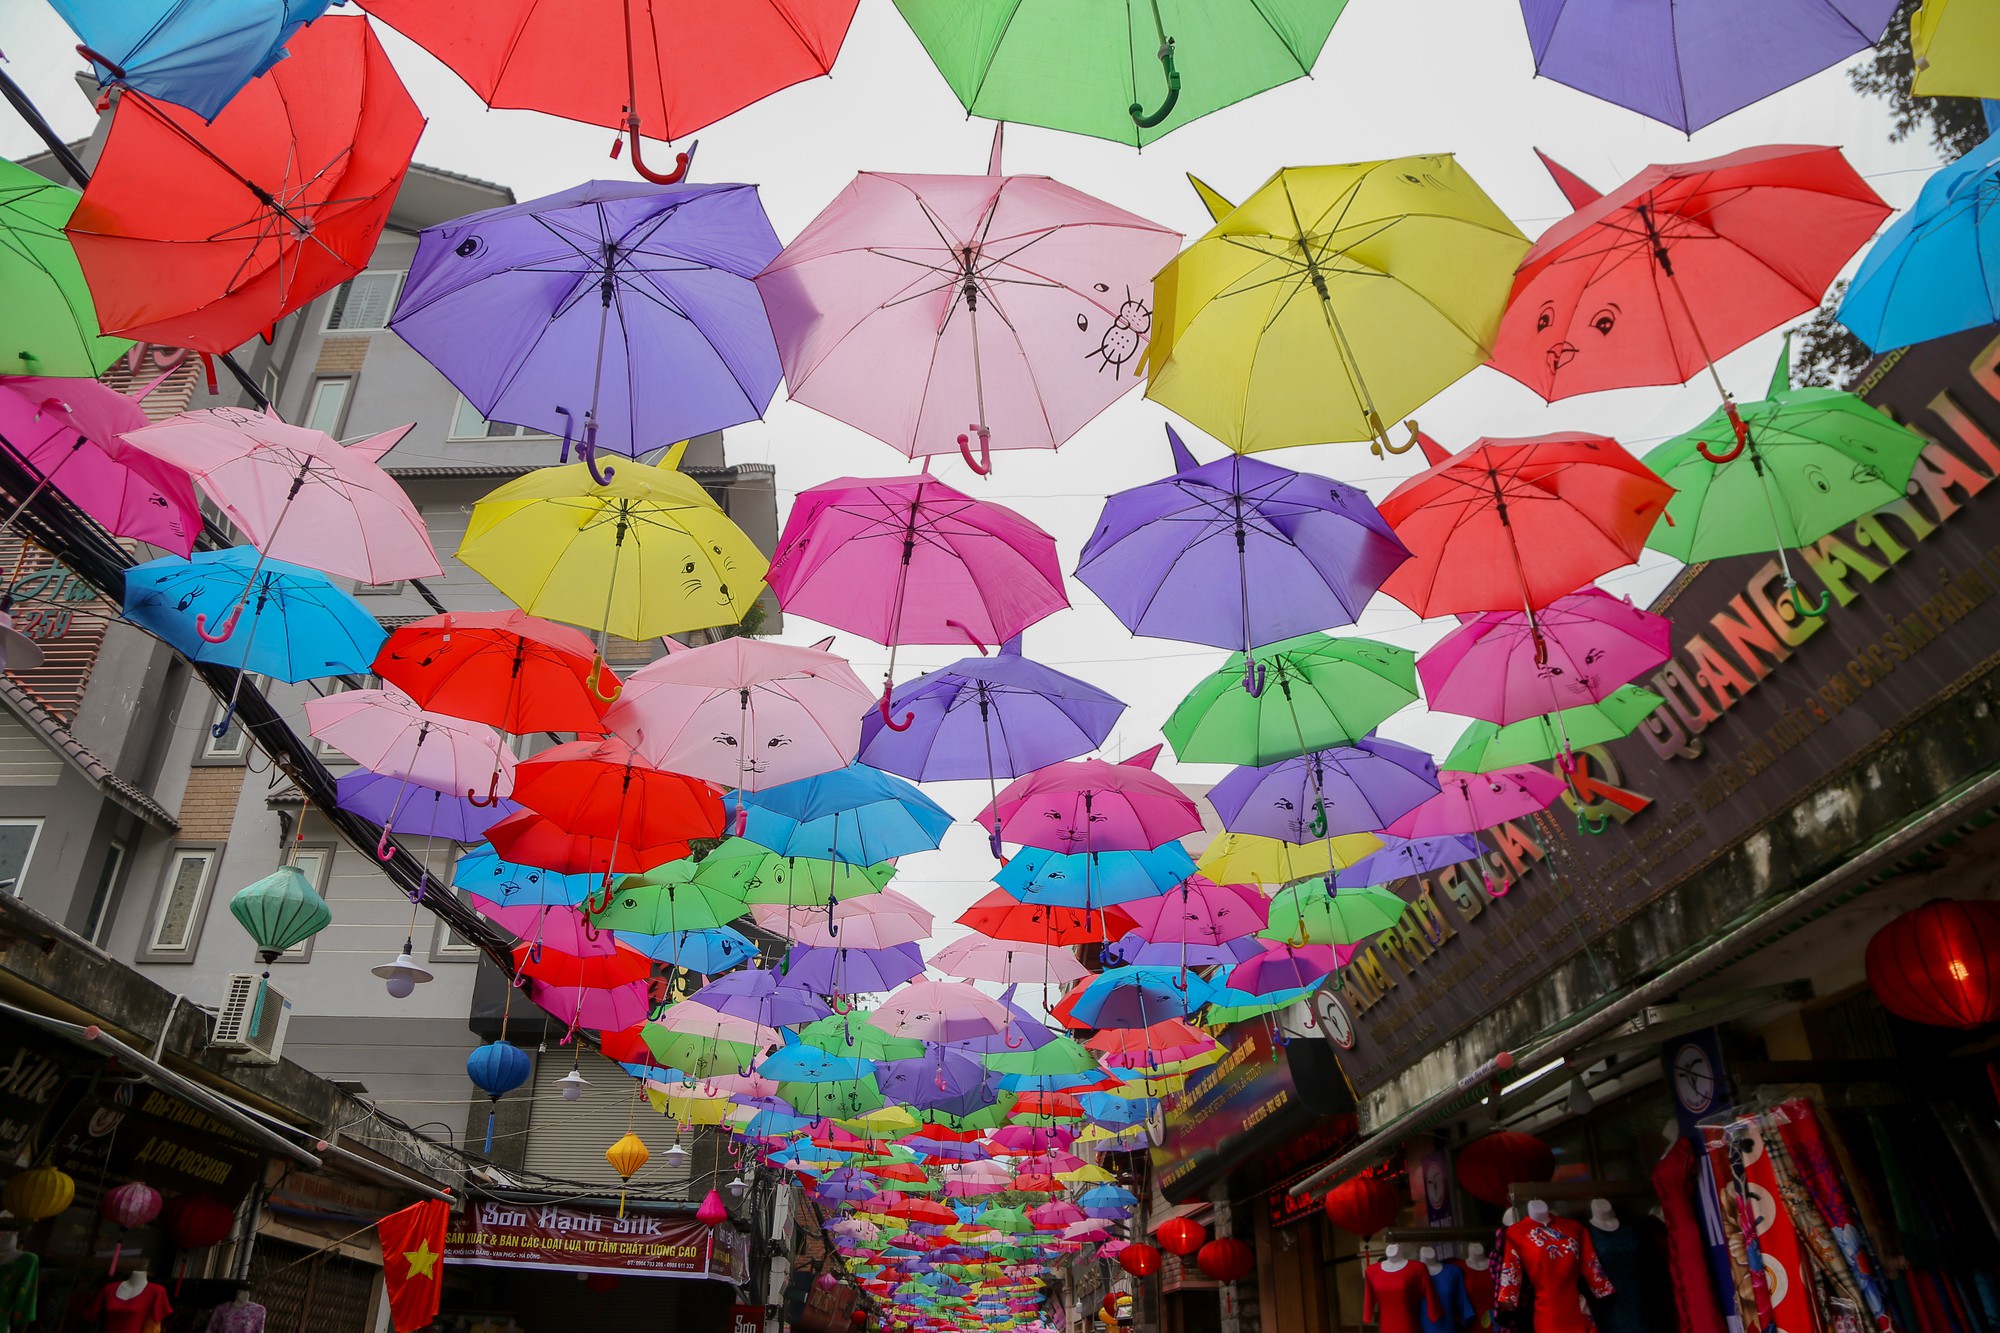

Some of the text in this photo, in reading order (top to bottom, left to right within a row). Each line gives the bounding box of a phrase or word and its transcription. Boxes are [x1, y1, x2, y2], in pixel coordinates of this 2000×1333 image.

[1339, 946, 1398, 1020] KIM
[481, 1201, 663, 1236] Sơn Hạnh Silk
[466, 1228, 487, 1245] XUẤT
[489, 1235, 498, 1246] &
[499, 1232, 520, 1248] BÁN
[520, 1234, 540, 1249] CÁC
[541, 1238, 563, 1252] LOẠI
[564, 1239, 582, 1253] LỤA
[584, 1240, 595, 1251] TƠ
[619, 1239, 644, 1255] CHẤT
[645, 1244, 676, 1259] LƯỢNG
[677, 1246, 697, 1258] CAO
